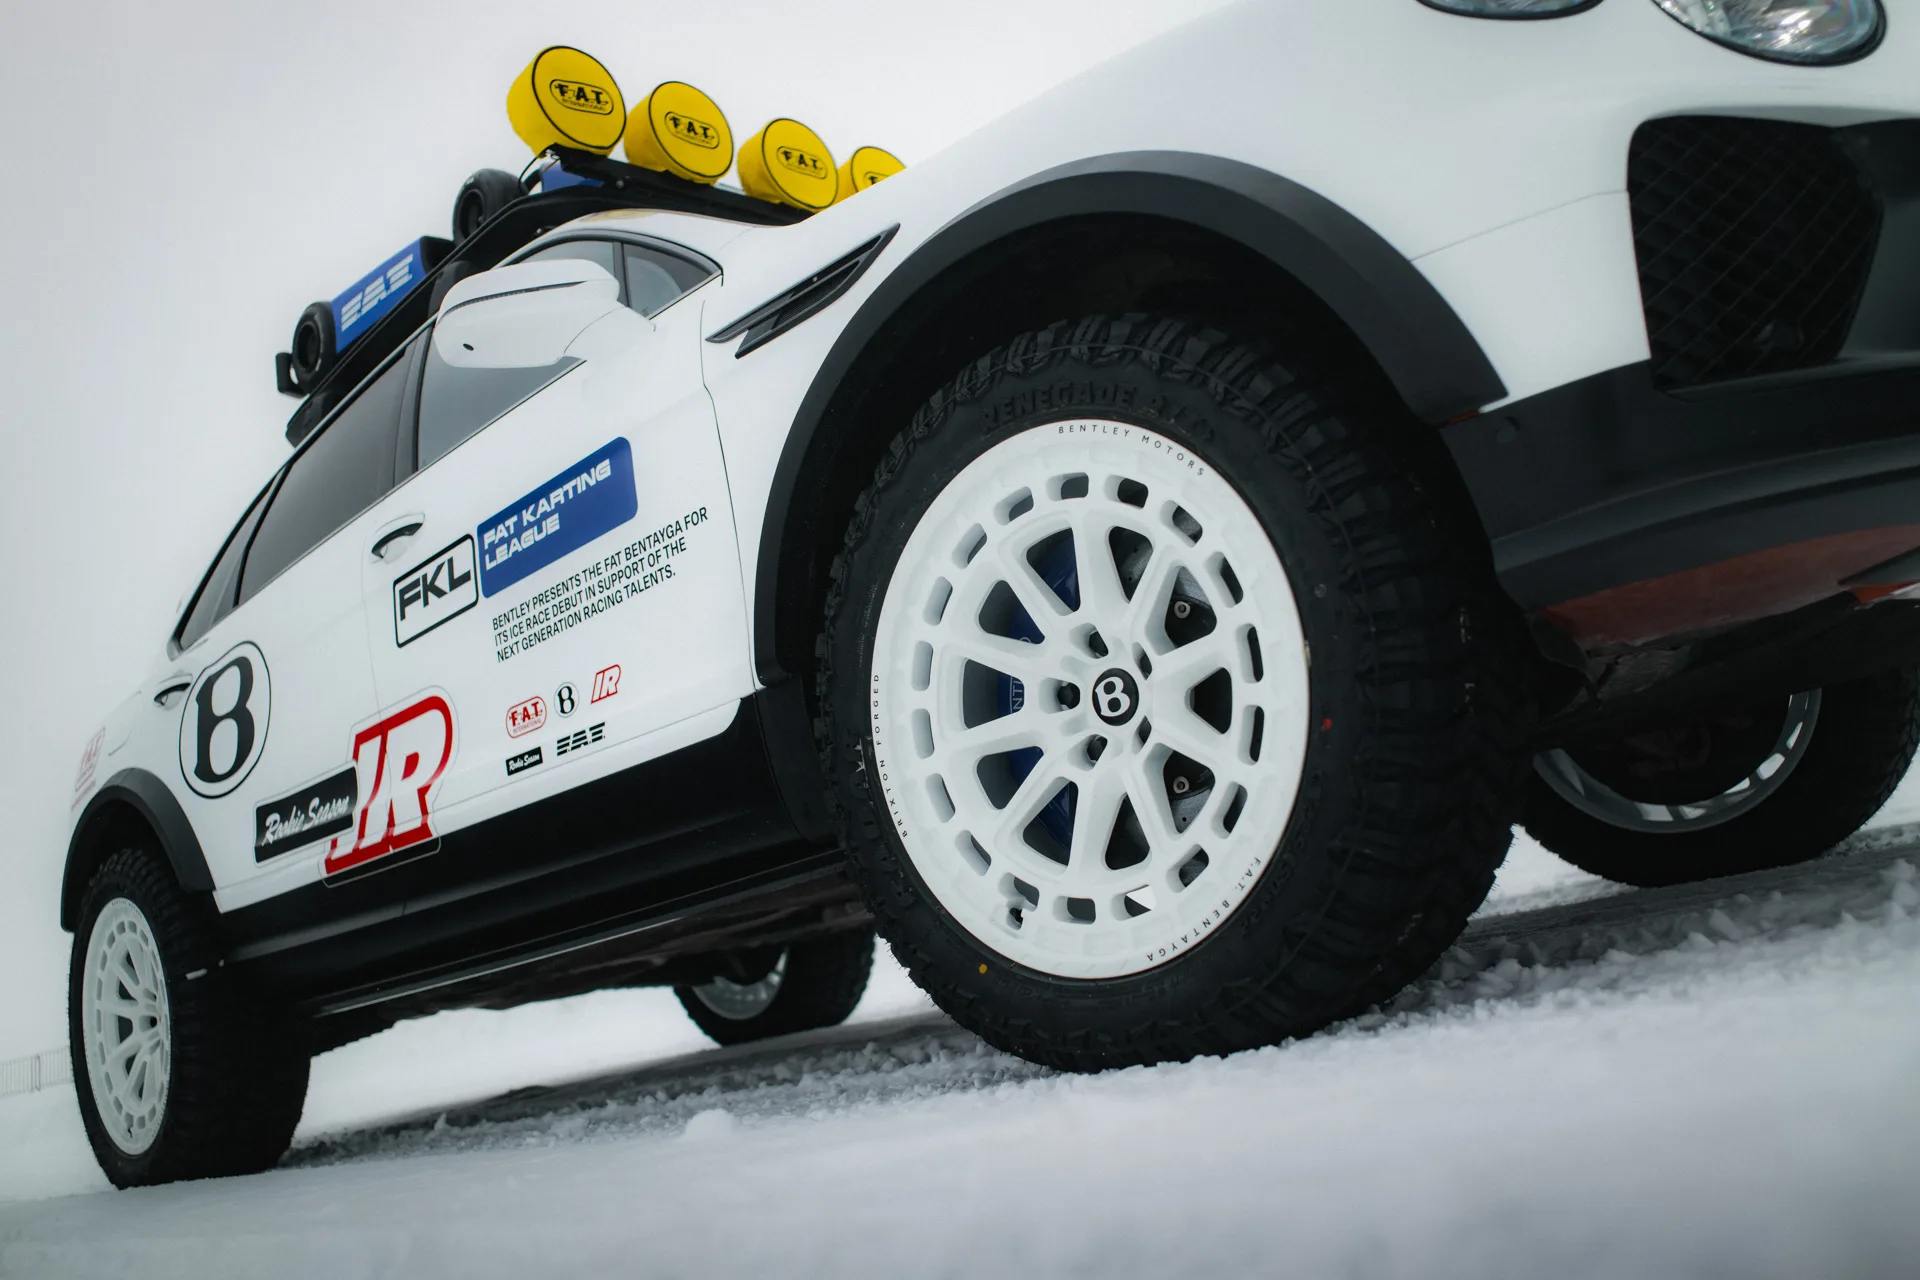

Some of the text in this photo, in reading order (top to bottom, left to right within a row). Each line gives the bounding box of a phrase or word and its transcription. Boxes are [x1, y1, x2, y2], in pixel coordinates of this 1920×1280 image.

[978, 380, 1138, 434] RENEGADE
[1058, 424, 1205, 476] BENTLEY MOTORS
[483, 458, 612, 550] FAT KARTING
[485, 512, 560, 571] LEAGUE
[492, 506, 708, 631] BENTLEY PRESENTS THE FAT BENTAYGA FOR
[398, 556, 471, 621] FKL
[494, 537, 687, 647] ITS ICE RACE DEBUT IN SUPPORT OF THE
[497, 564, 676, 663] NEXT GENERATION RACING TALENTS.
[873, 674, 883, 746] FORGED
[302, 796, 350, 831] Season
[879, 759, 908, 838] BRIXTON
[1234, 857, 1261, 891] F.A.T.
[1146, 900, 1230, 961] BENTAYGA
